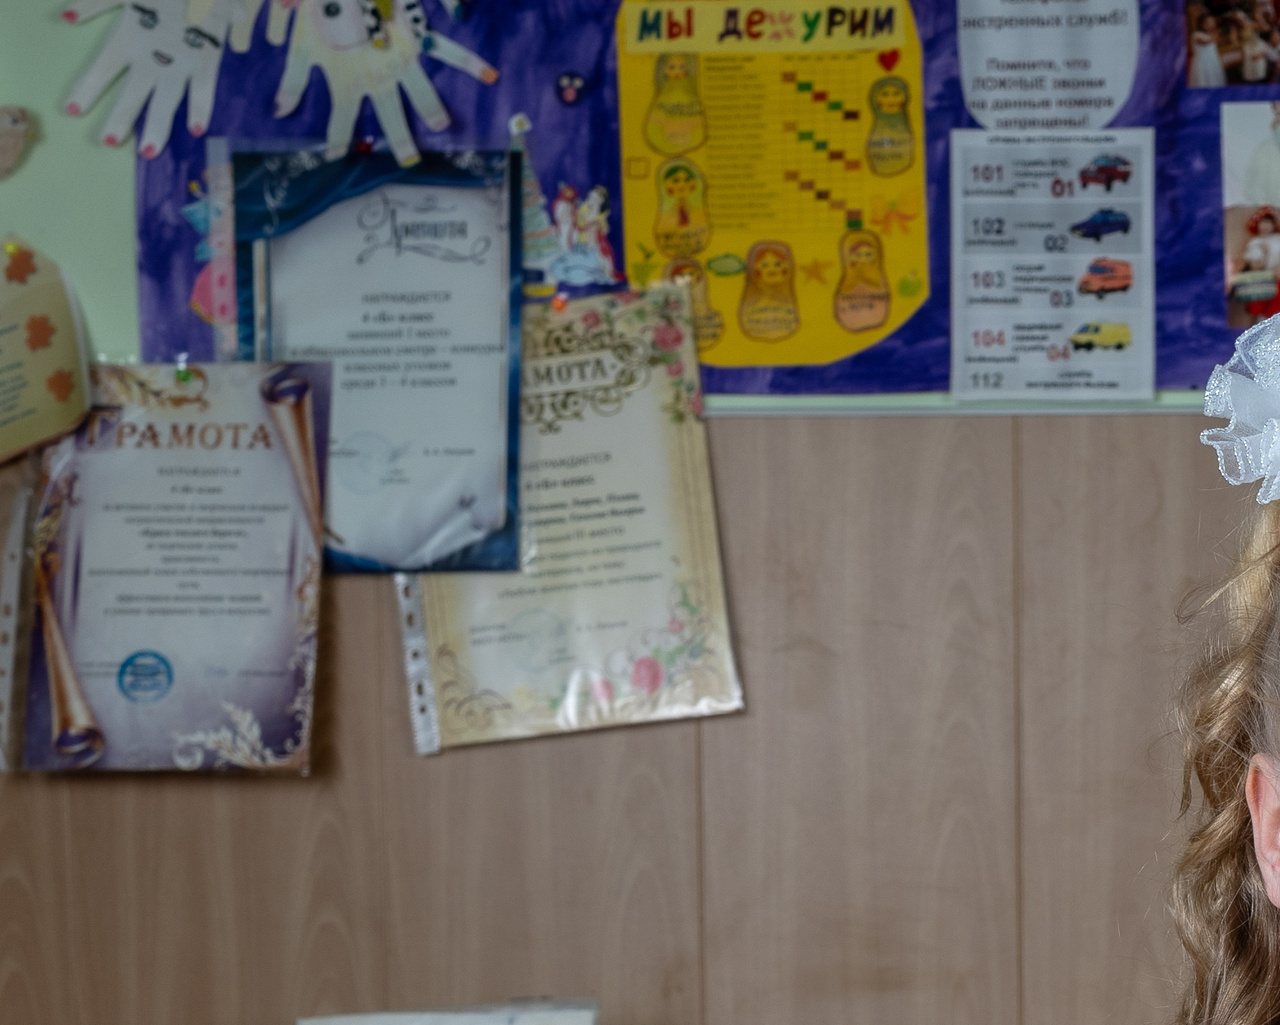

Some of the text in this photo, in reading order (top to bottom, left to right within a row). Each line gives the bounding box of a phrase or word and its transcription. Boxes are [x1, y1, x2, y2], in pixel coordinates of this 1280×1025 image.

[972, 165, 1004, 182] 101
[1051, 179, 1075, 198] 01
[972, 217, 1005, 236] 102
[1044, 234, 1069, 252] 02
[971, 271, 1005, 289] 103
[1050, 290, 1073, 308] 03
[972, 330, 1006, 347] 104
[1046, 343, 1071, 361] 04
[971, 371, 1003, 388] 112
